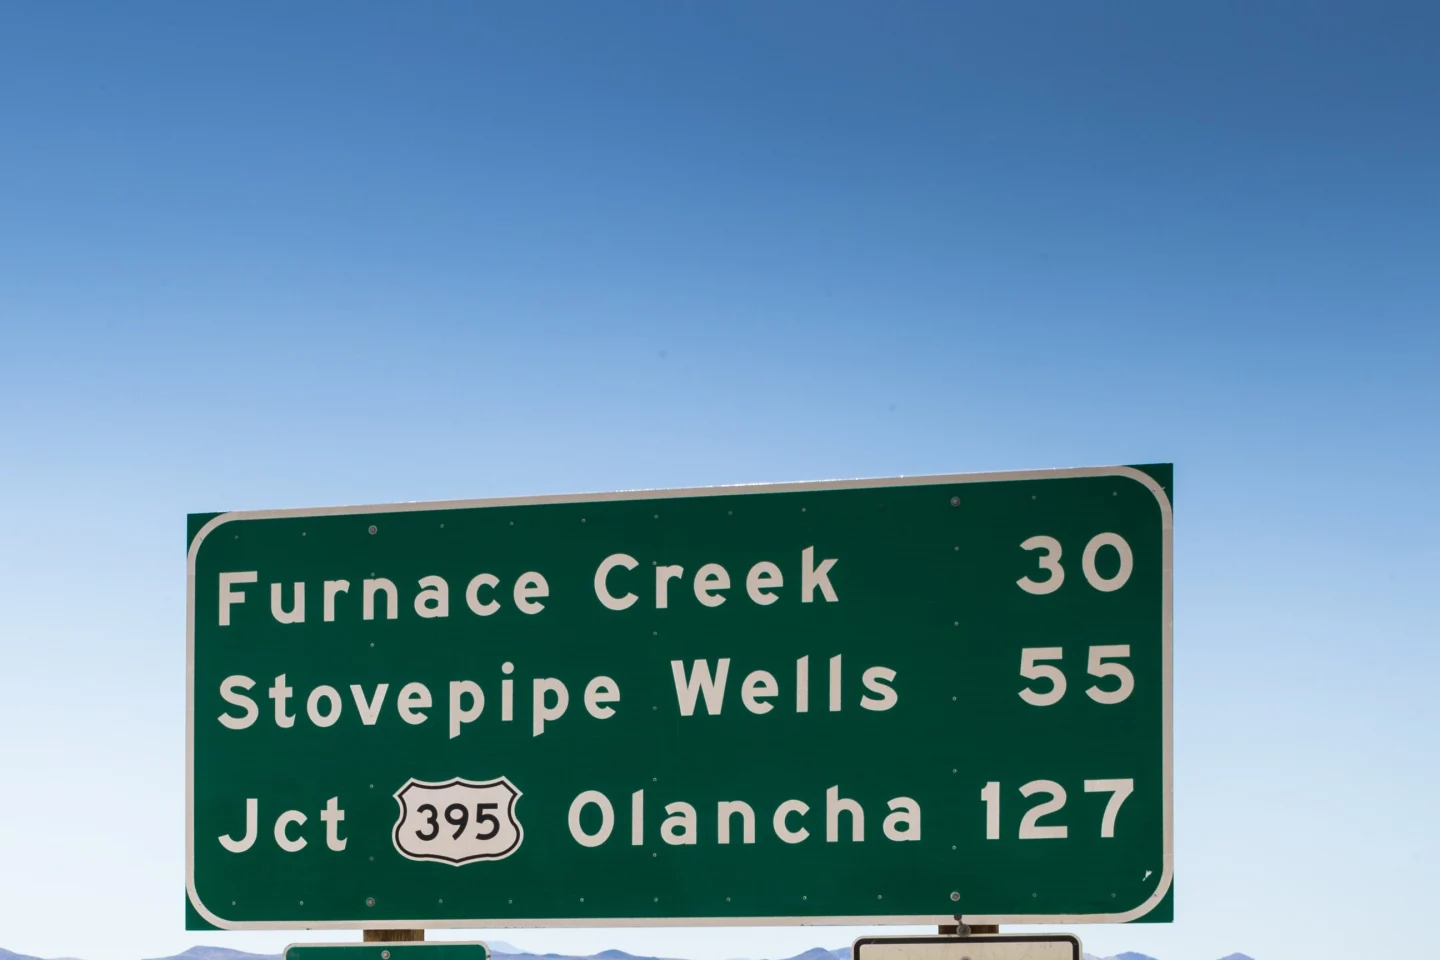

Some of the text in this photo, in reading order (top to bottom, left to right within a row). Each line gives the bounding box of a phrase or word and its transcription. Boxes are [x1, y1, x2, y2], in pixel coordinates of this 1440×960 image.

[218, 532, 1134, 626] Furnace Creek 30
[217, 644, 1135, 740] Stovepipe Wells 55
[217, 778, 1134, 854] Jct 395 Olancha 127
